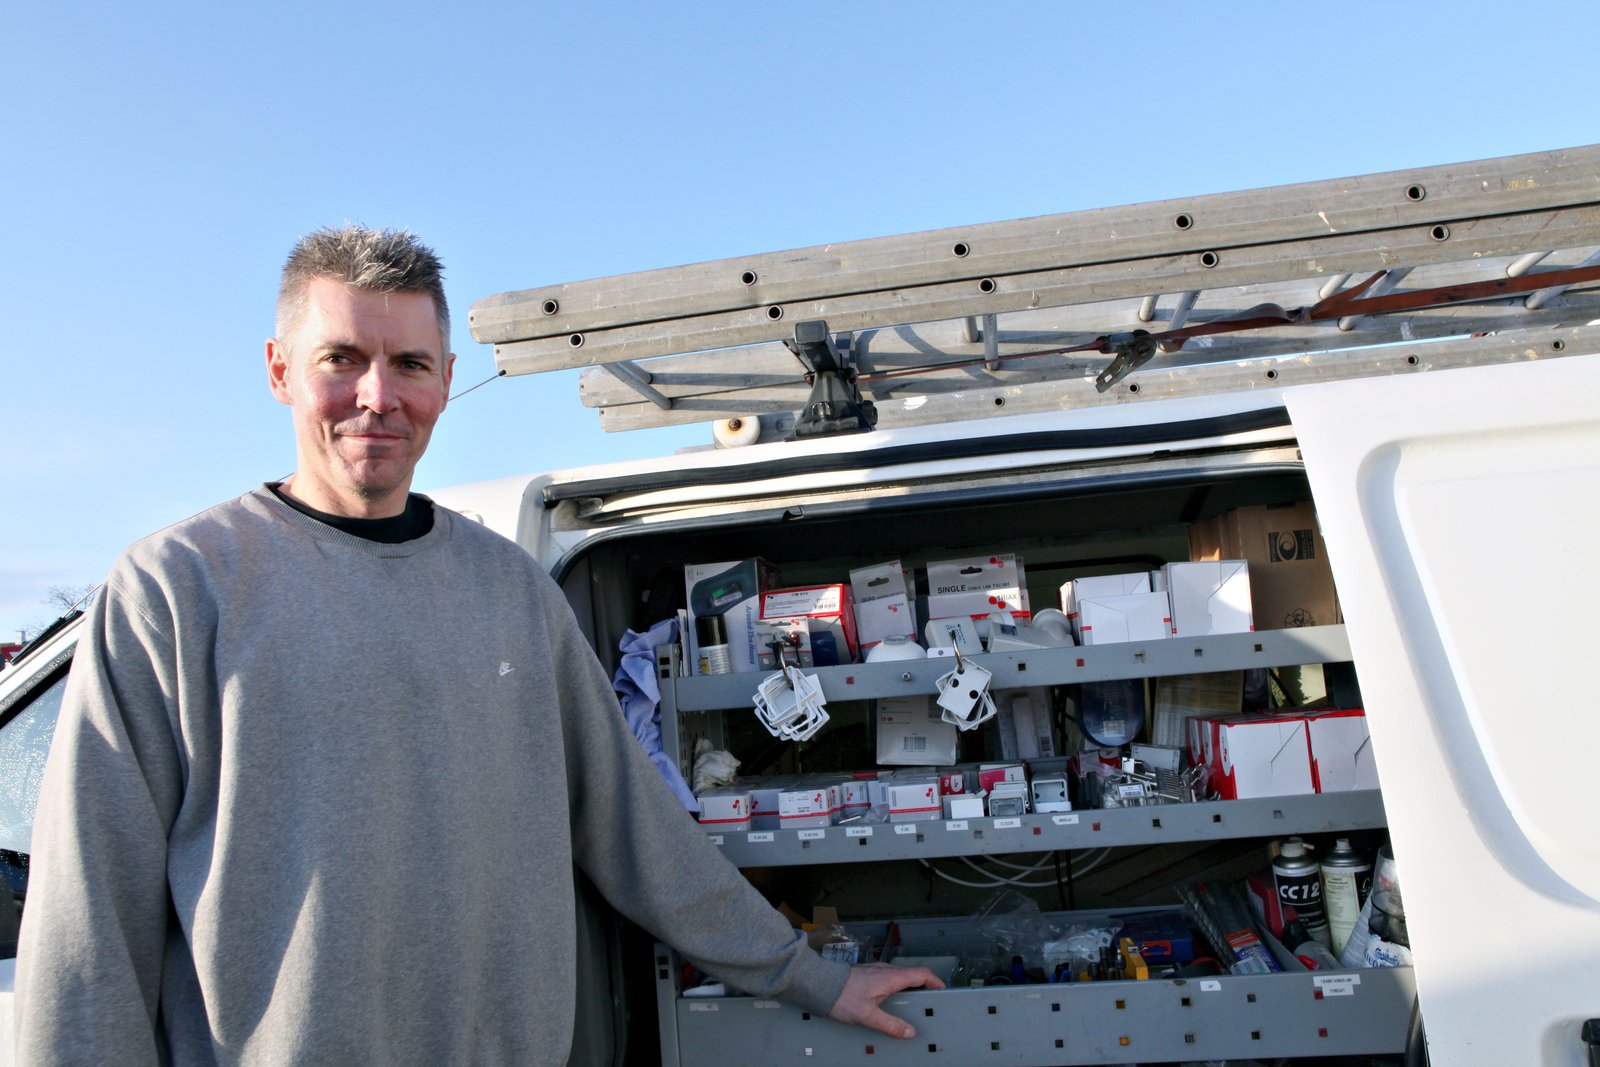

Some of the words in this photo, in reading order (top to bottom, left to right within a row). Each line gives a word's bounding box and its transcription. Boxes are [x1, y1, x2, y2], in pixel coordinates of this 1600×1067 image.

[937, 584, 967, 594] SINGLE
[997, 593, 1017, 601] TRIAX
[745, 605, 754, 630] Around
[747, 631, 755, 643] The
[748, 644, 756, 665] House
[1279, 881, 1320, 900] CC12
